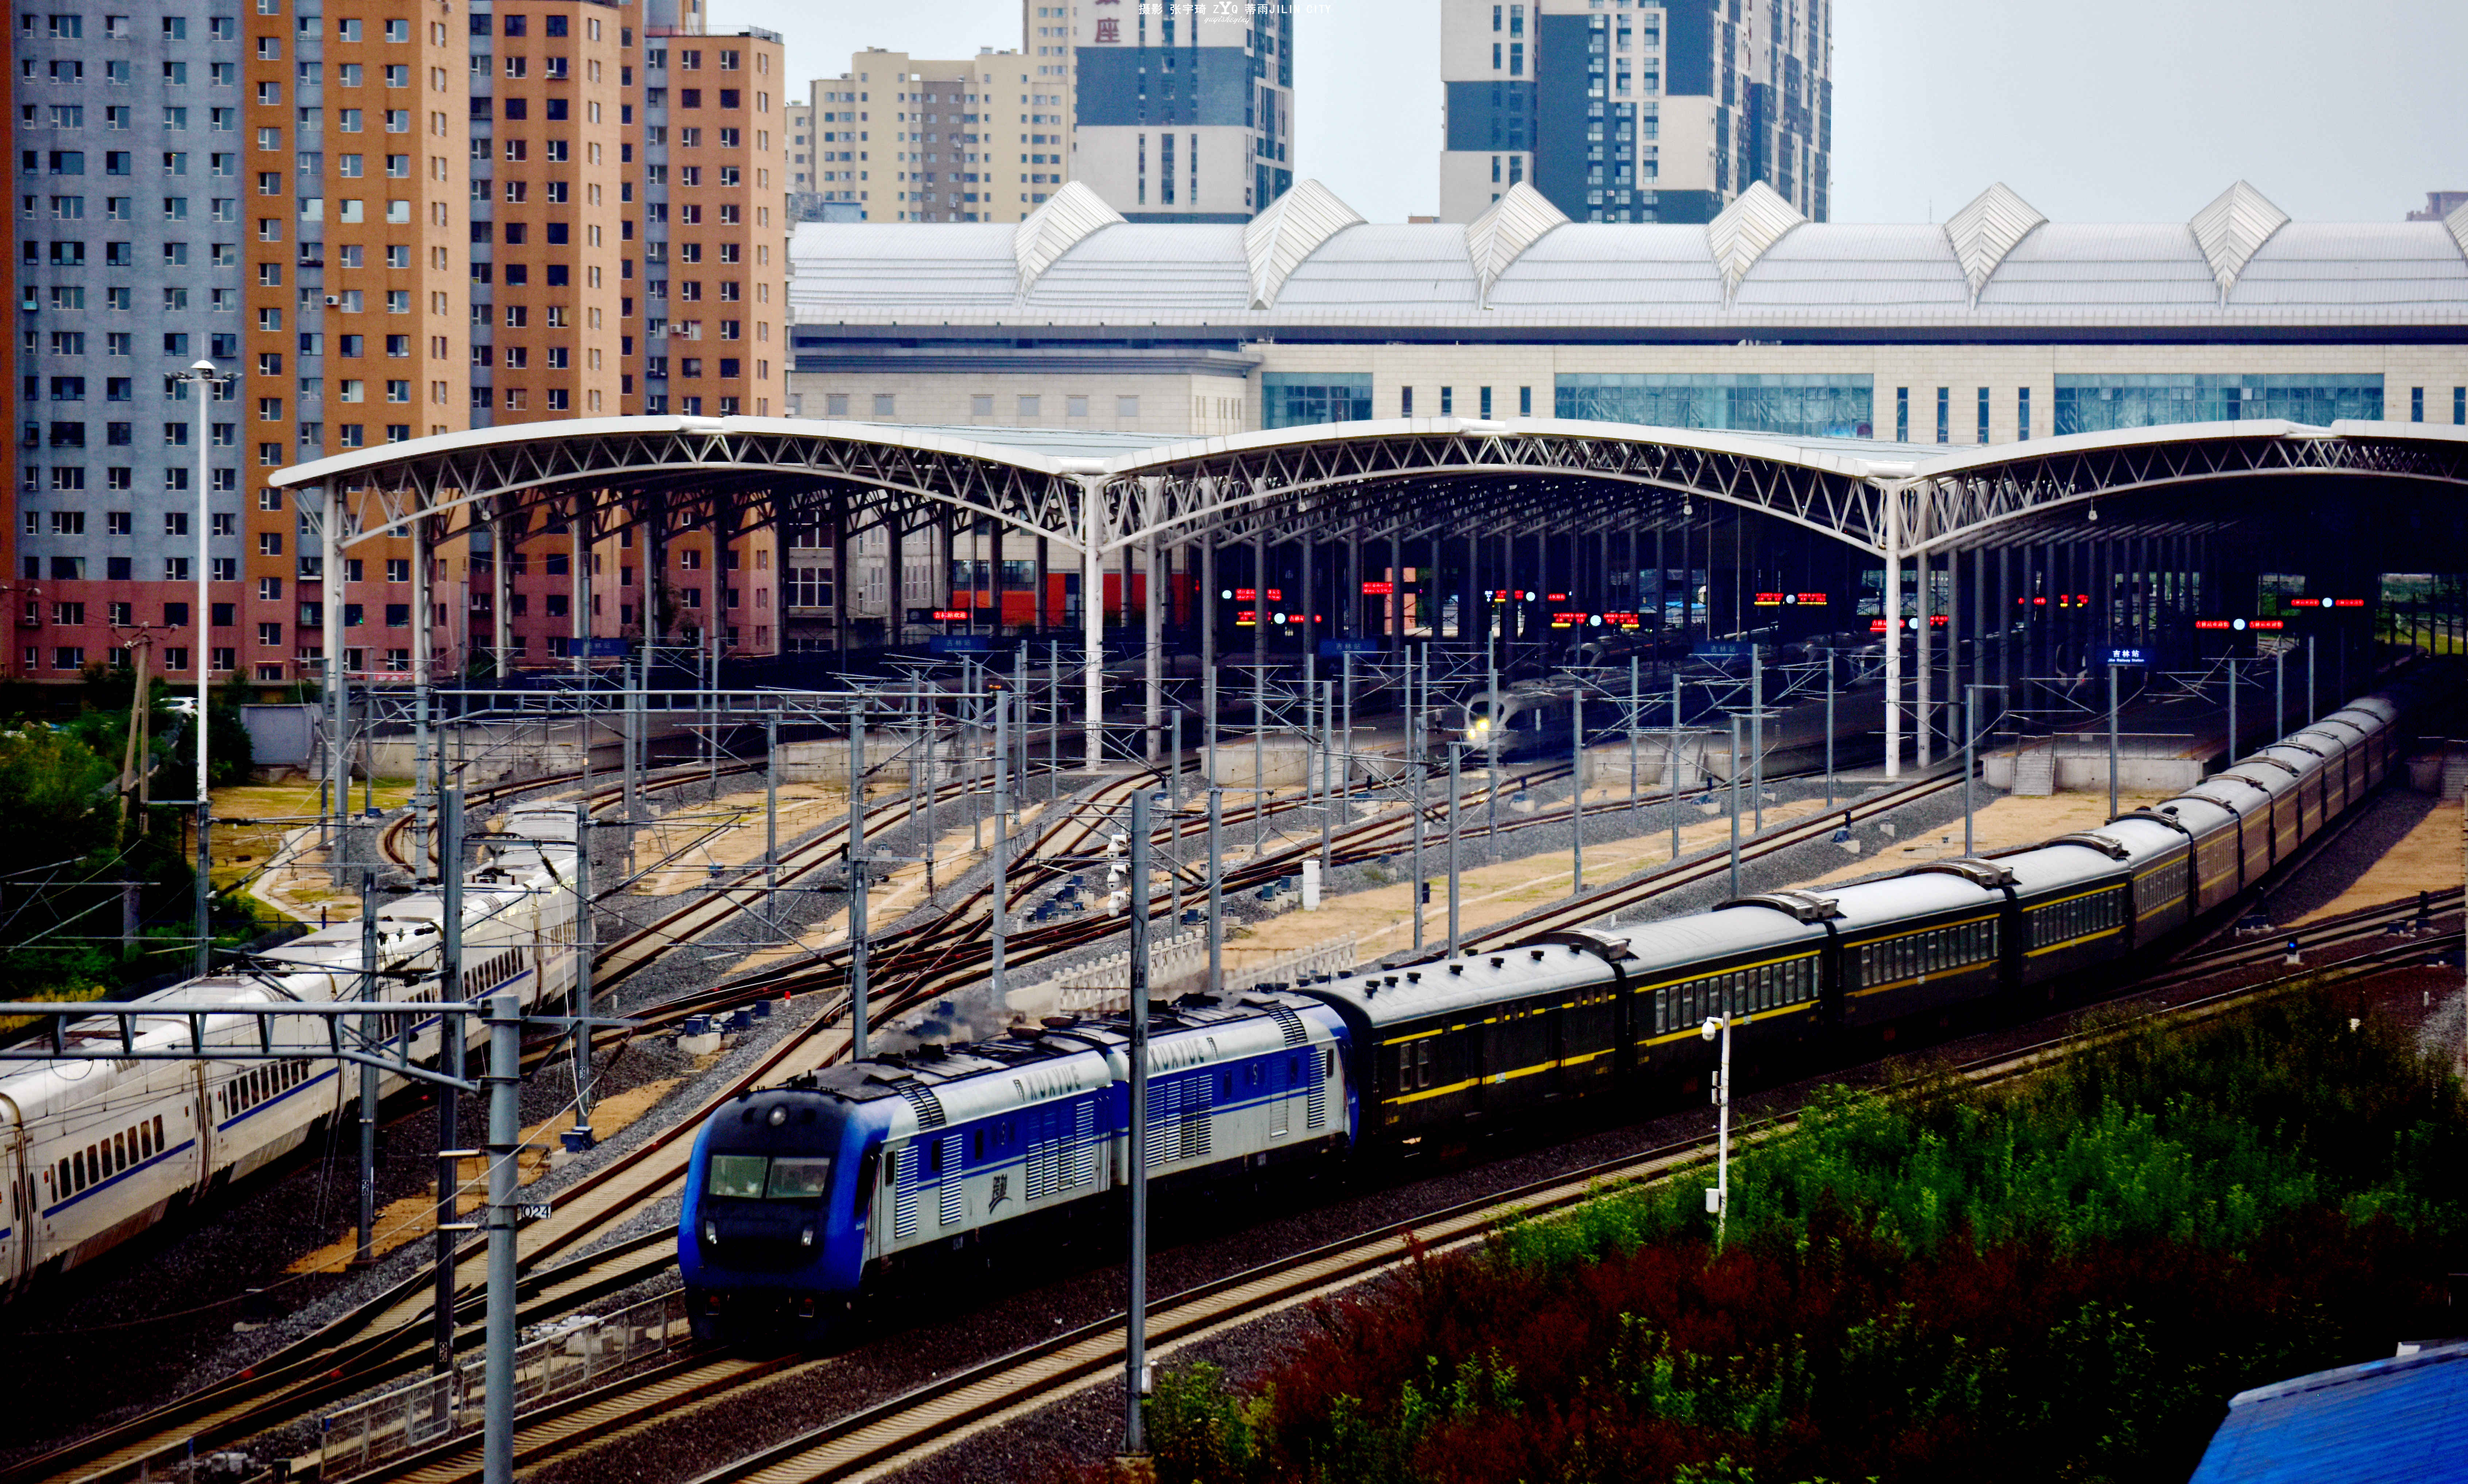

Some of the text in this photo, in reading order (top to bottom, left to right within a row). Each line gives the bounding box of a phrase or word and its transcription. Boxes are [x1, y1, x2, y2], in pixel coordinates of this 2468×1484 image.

[1095, 0, 1120, 43] 座
[2113, 650, 2139, 658] 吉林站
